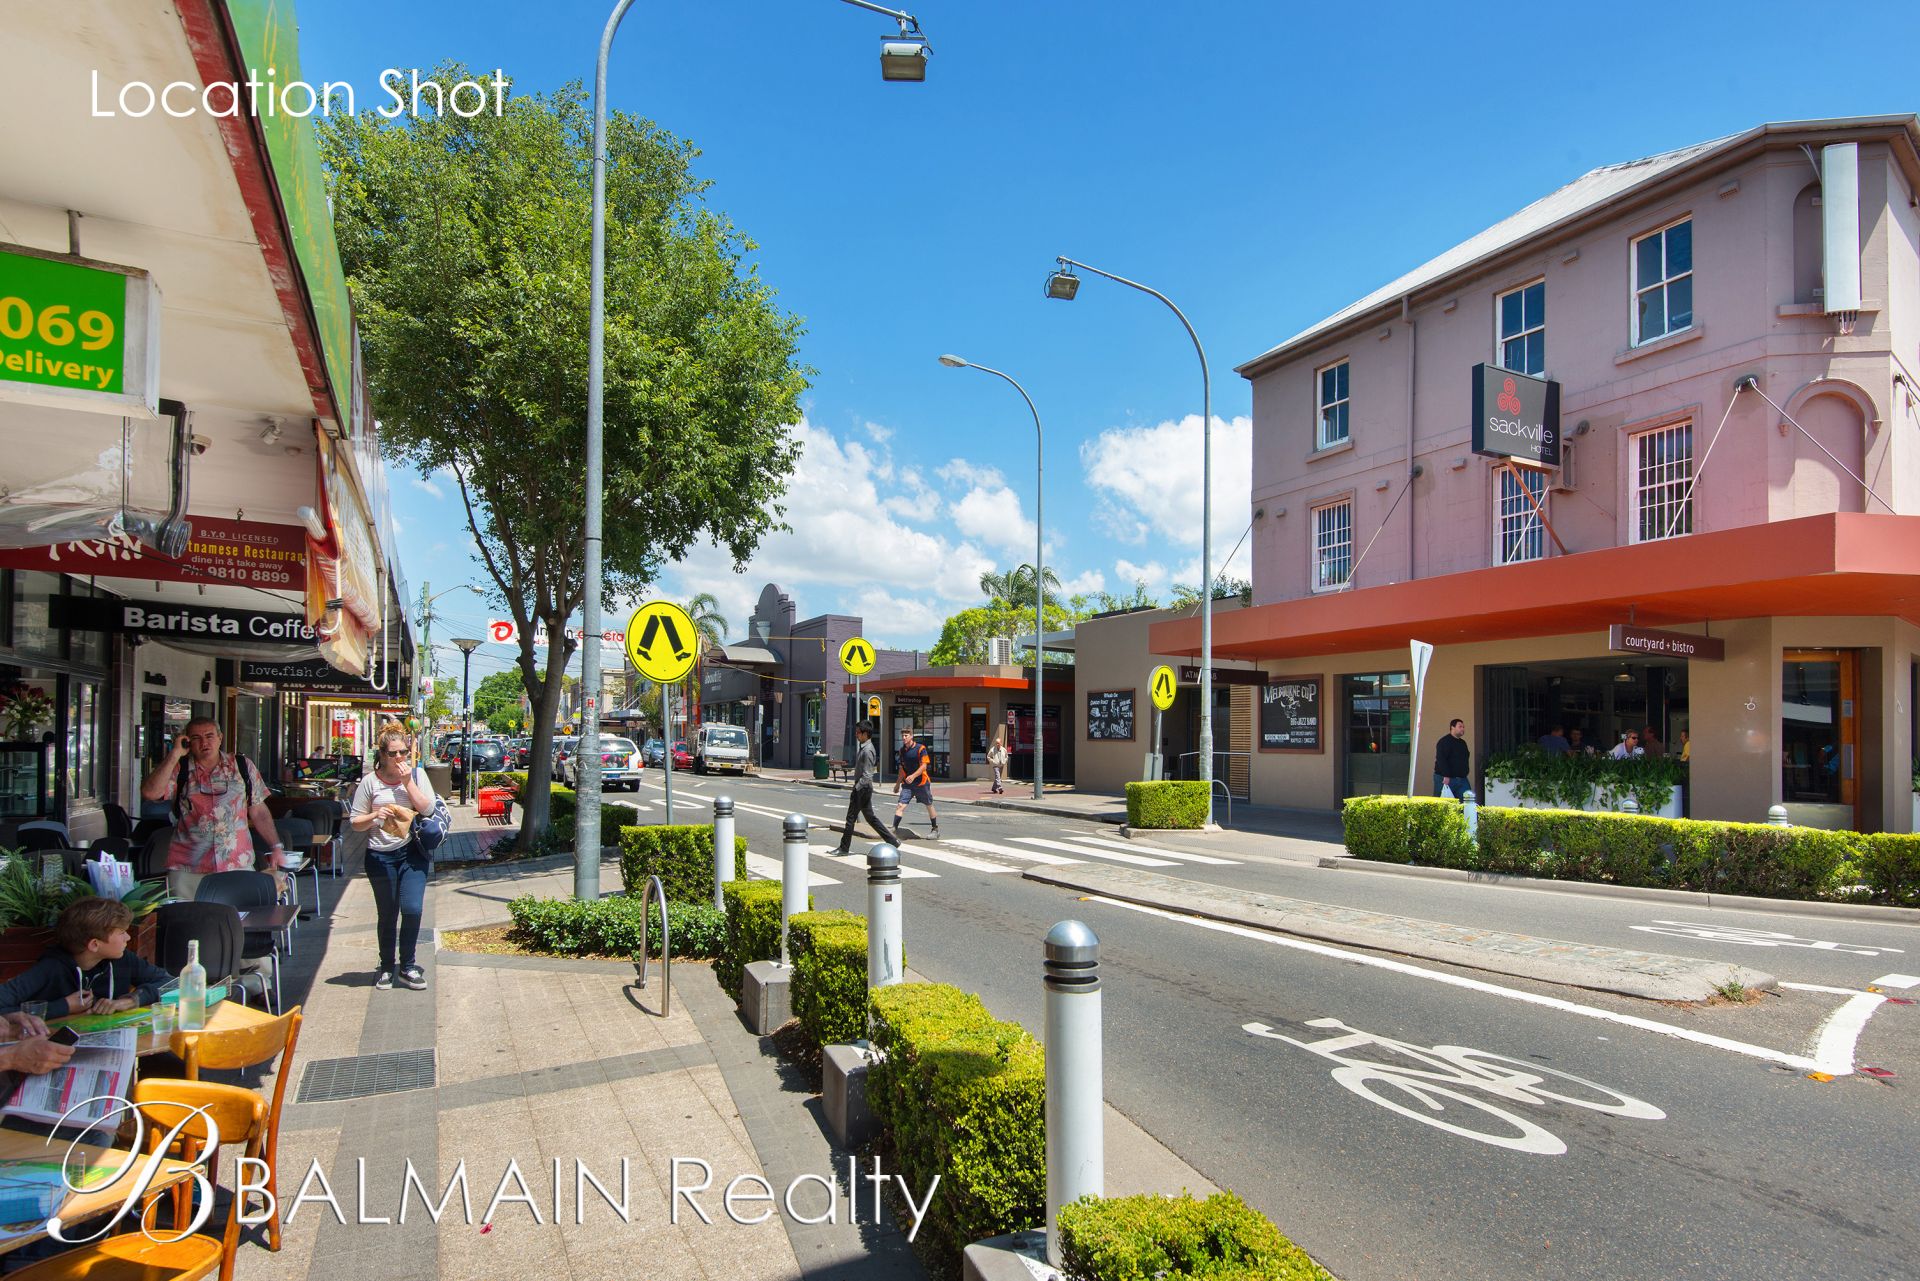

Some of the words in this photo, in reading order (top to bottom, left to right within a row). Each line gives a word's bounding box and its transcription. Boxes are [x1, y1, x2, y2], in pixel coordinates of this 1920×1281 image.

[1489, 417, 1553, 444] sackville
[1530, 444, 1553, 456] HOTEL
[232, 533, 279, 544] LICENSED
[187, 540, 239, 557] tnamese
[191, 555, 213, 565] dine
[215, 556, 224, 565] in
[227, 558, 234, 566] &
[236, 559, 257, 568] take
[259, 562, 283, 572] away
[207, 566, 247, 580] 9810
[251, 569, 290, 584] 8899
[123, 606, 240, 635] Barista
[249, 616, 316, 640] Coffe
[1625, 636, 1665, 651] courtyard
[1672, 640, 1694, 654] bistro
[248, 664, 313, 678] love.fish
[1263, 684, 1300, 704] MELBOURNE
[1301, 683, 1317, 702] CUP
